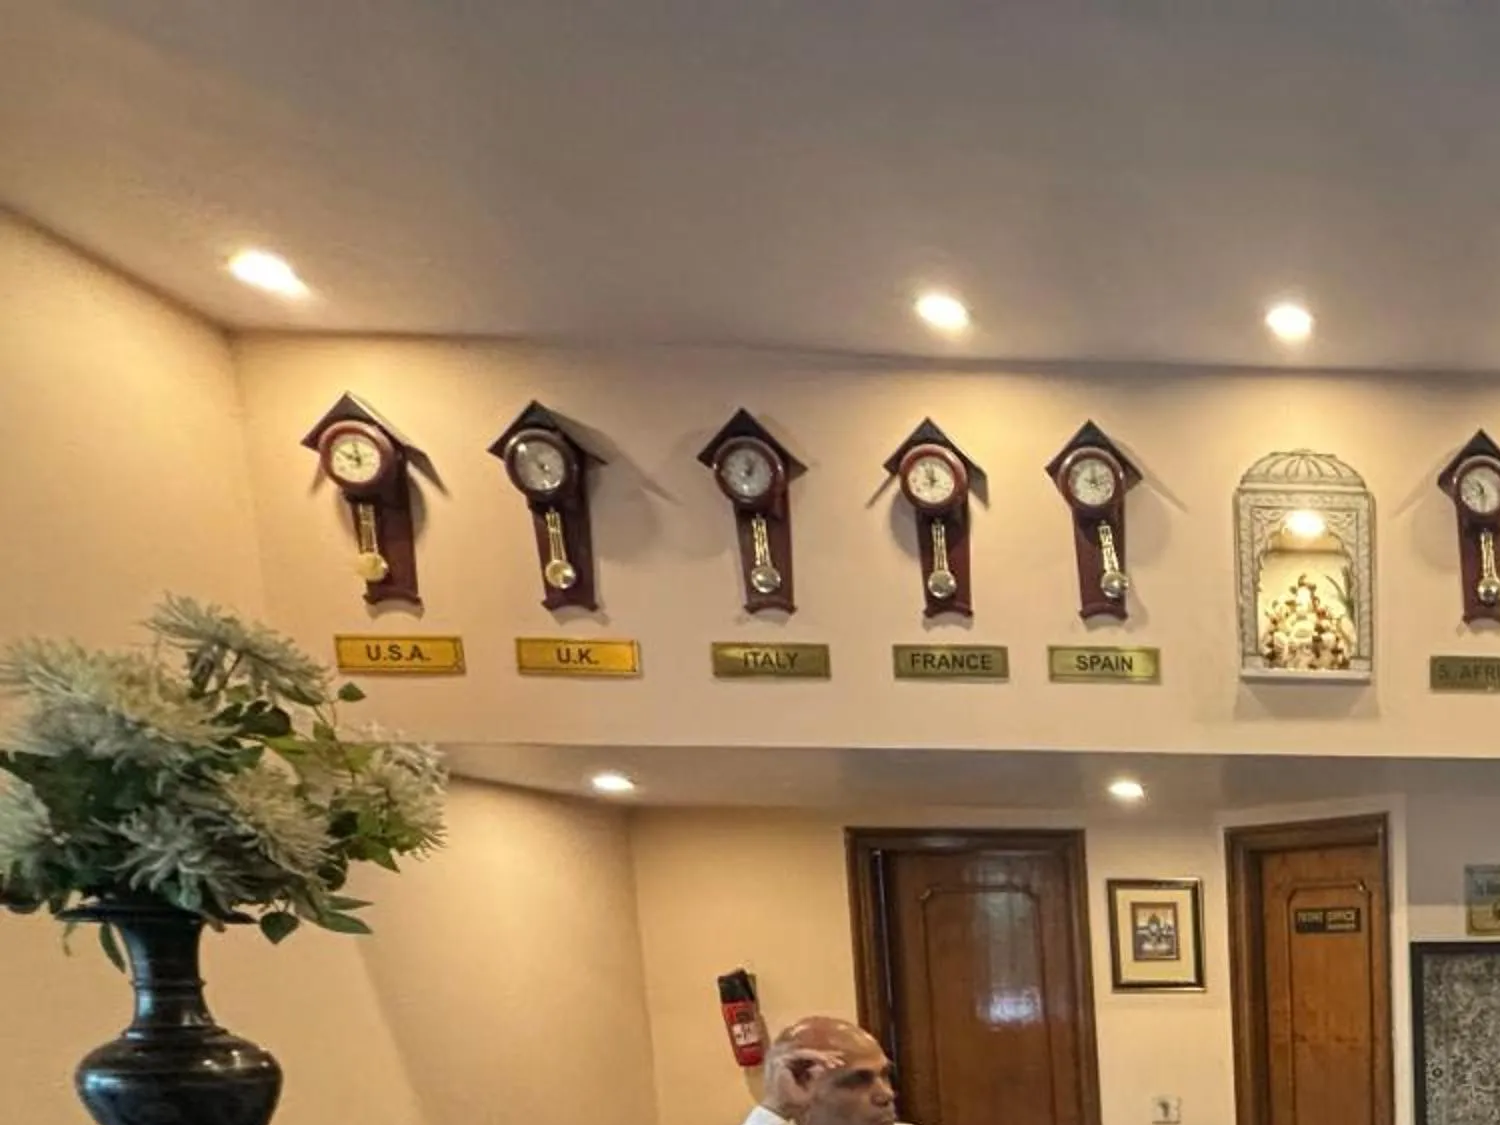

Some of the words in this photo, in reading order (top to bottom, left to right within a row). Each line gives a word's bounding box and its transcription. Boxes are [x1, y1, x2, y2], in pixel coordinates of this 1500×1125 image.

[365, 643, 431, 662] U.S.A.
[555, 646, 600, 665] U.K.
[742, 650, 799, 669] ITALY
[910, 652, 993, 671] FRANCE
[1075, 654, 1134, 673] SPAIN
